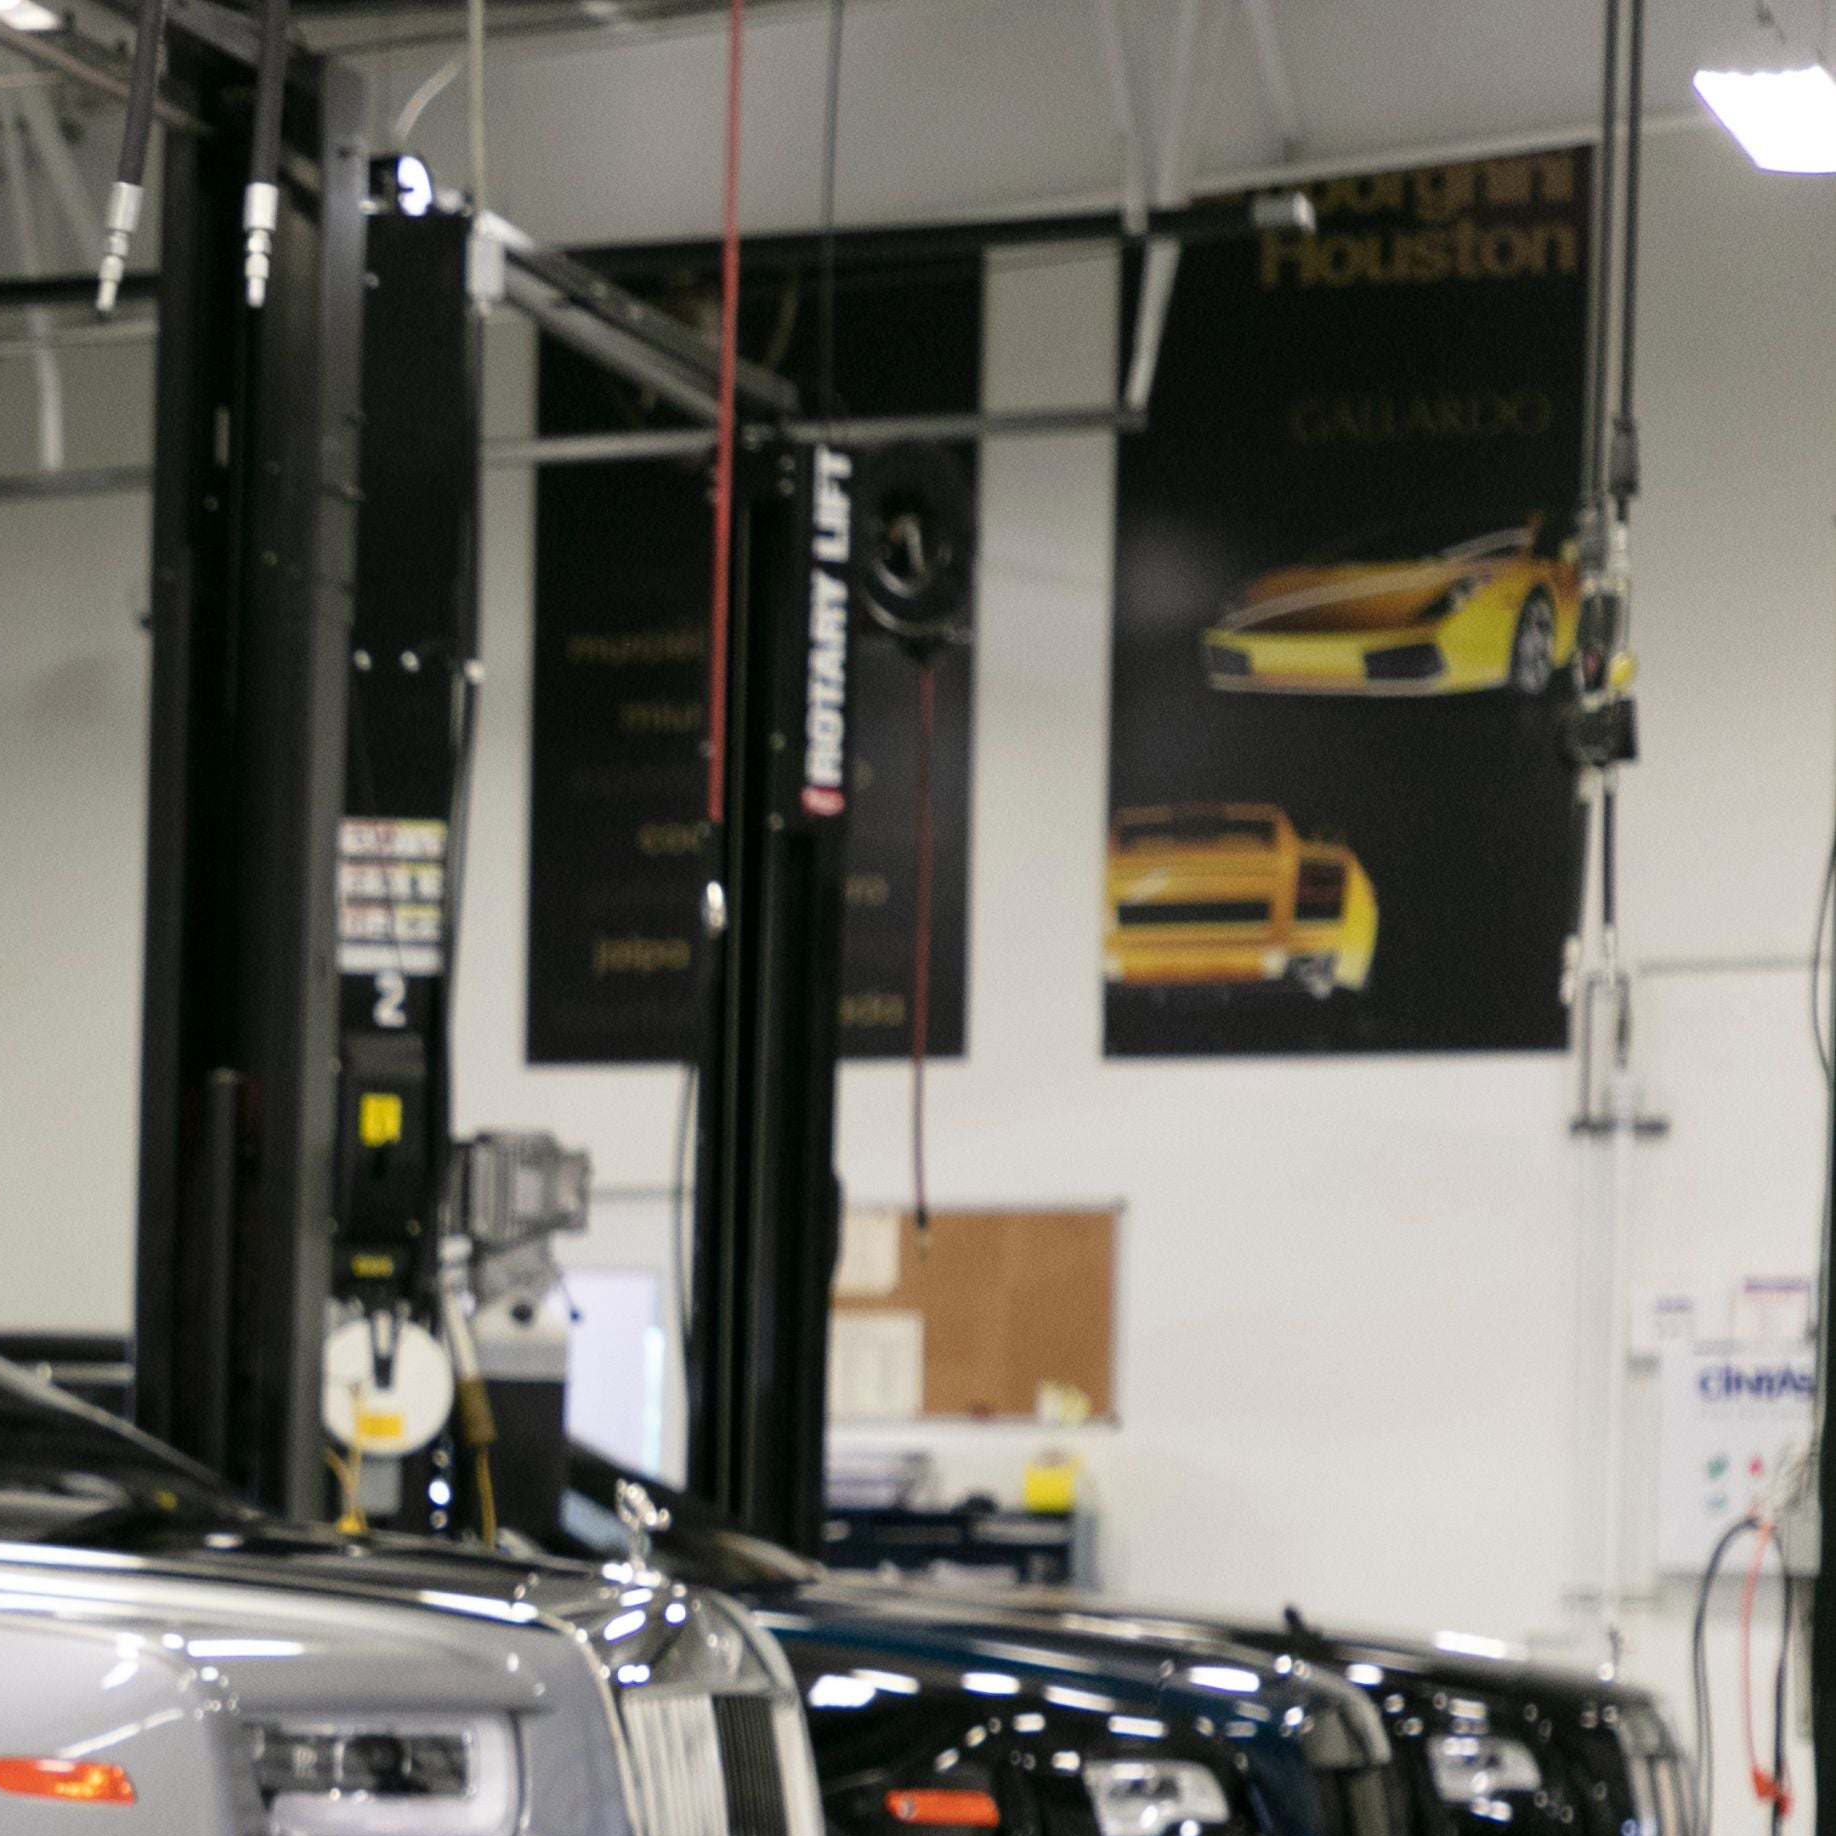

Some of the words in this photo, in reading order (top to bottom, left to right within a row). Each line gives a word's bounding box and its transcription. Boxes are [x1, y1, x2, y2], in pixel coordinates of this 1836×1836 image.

[1259, 219, 1577, 289] Houston
[812, 444, 853, 563] LIFT
[804, 566, 848, 788] ROTARY
[373, 970, 407, 1029] 2
